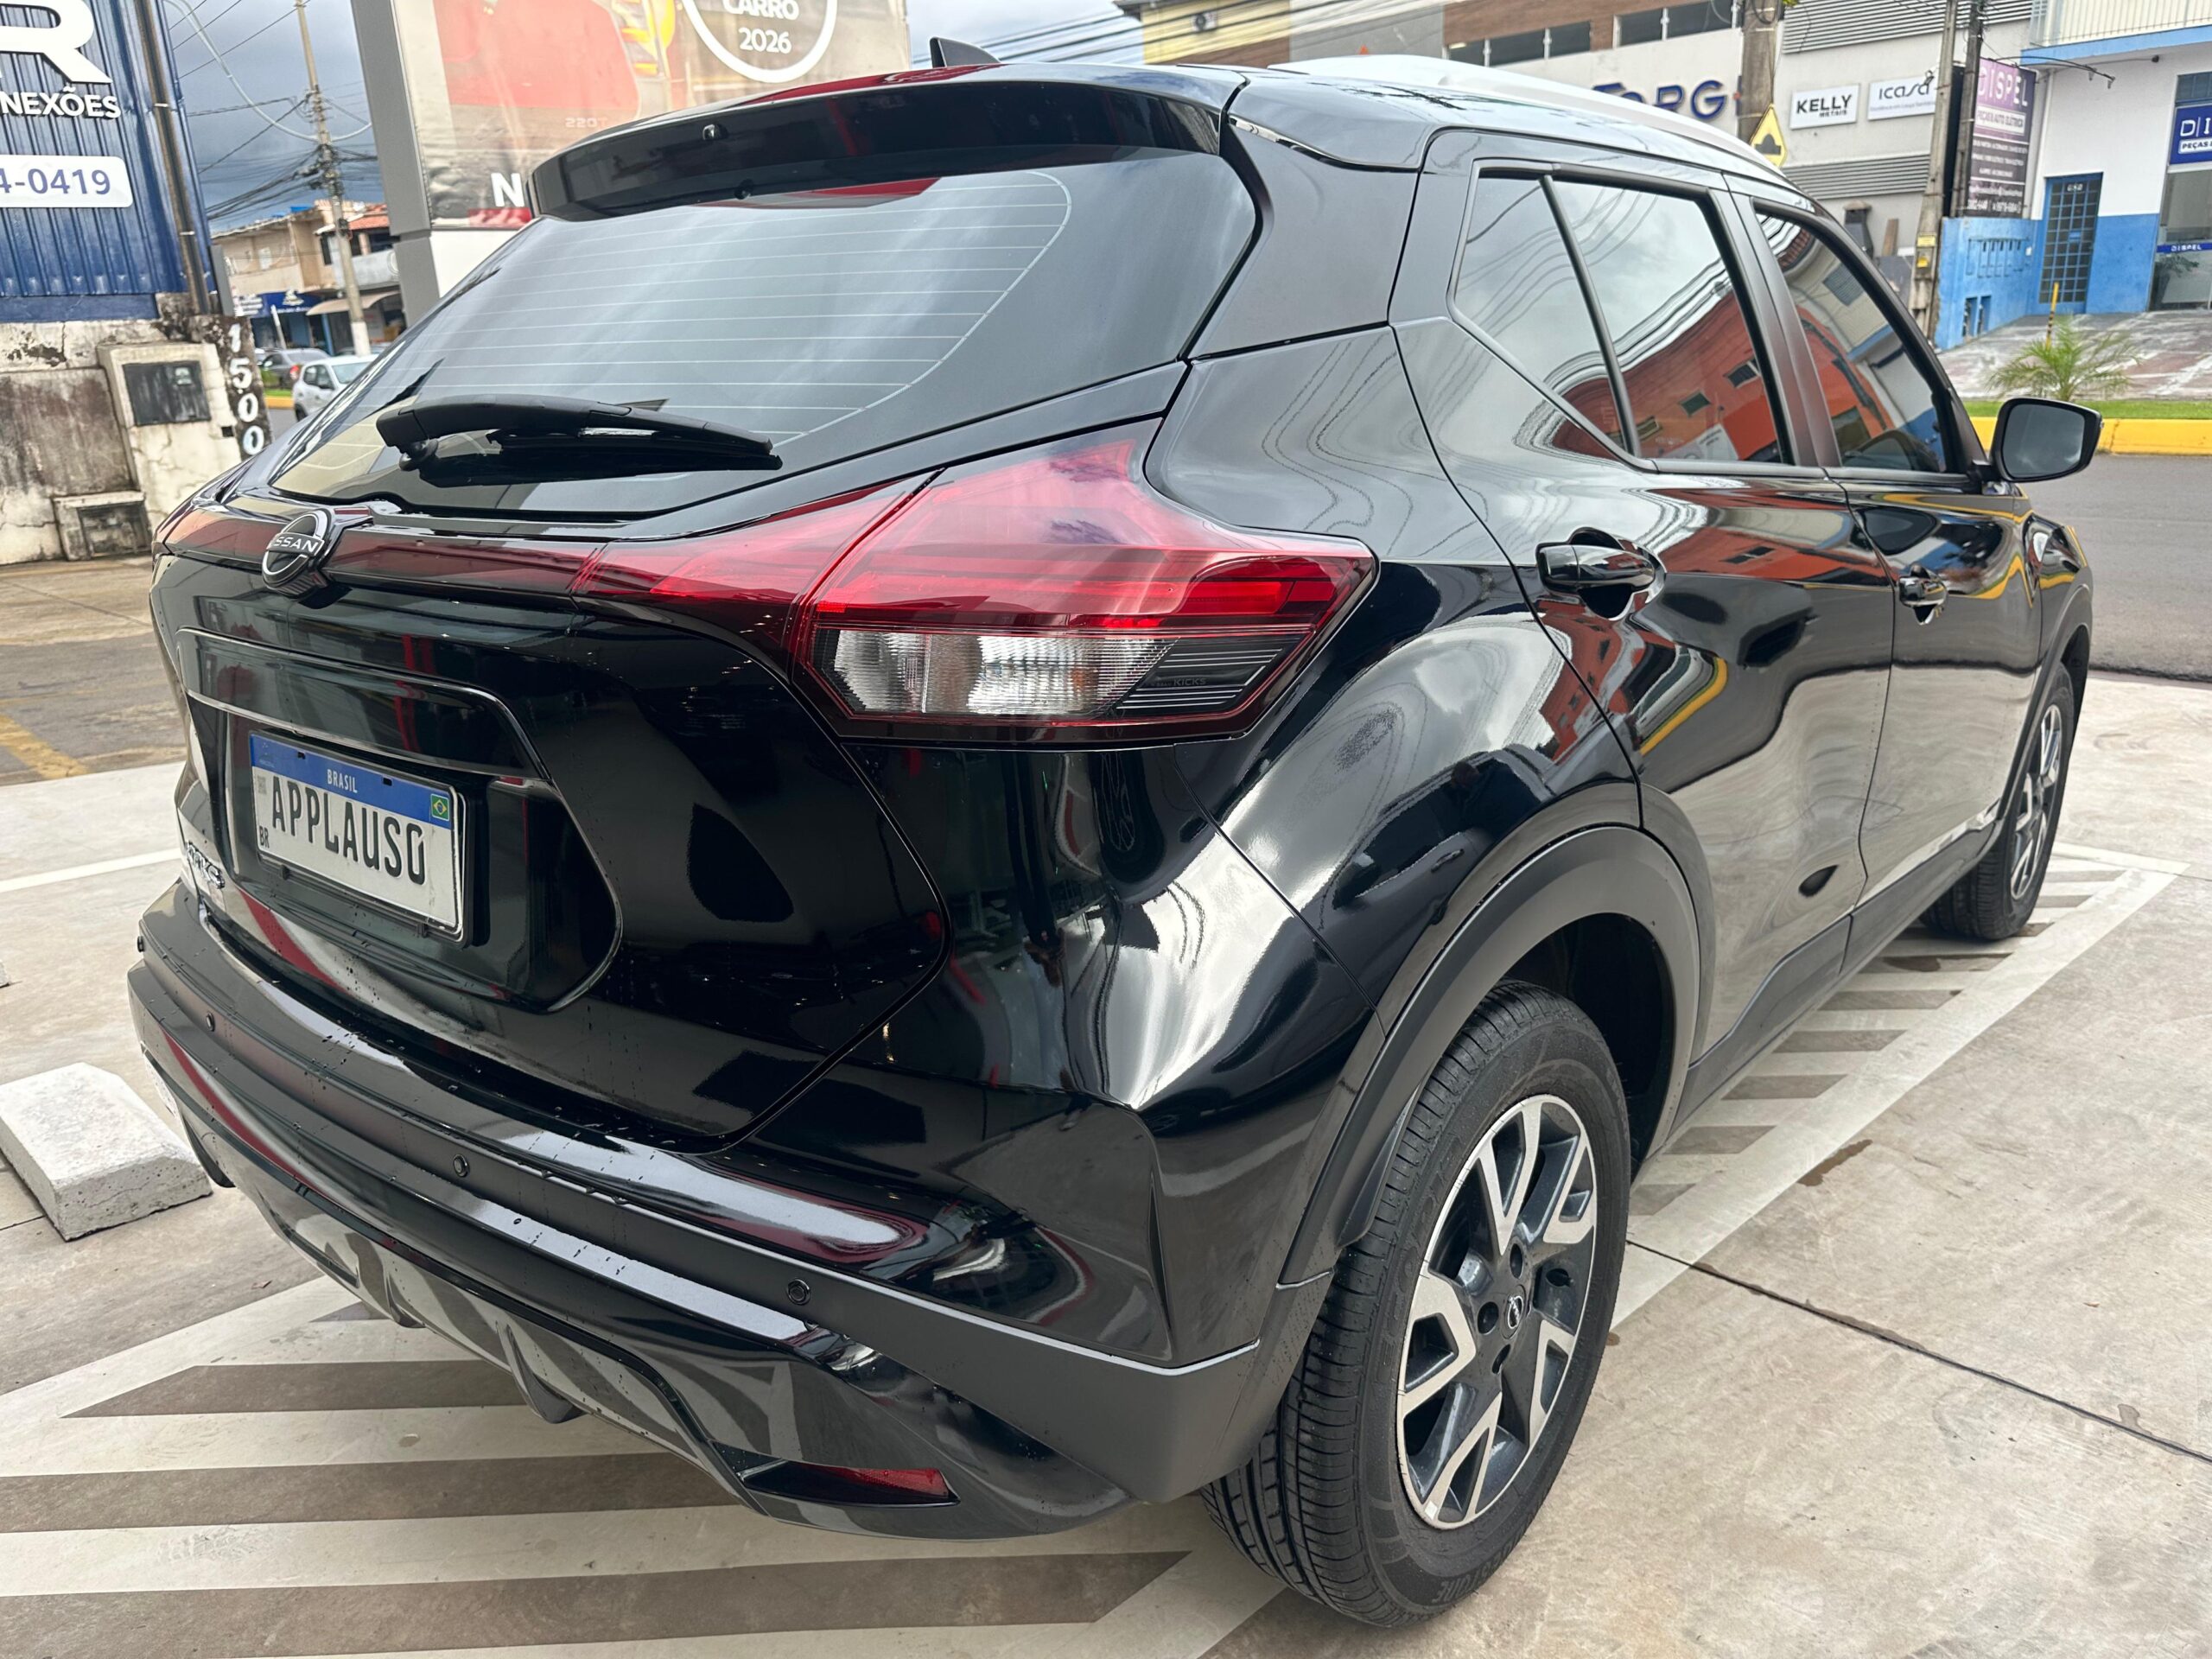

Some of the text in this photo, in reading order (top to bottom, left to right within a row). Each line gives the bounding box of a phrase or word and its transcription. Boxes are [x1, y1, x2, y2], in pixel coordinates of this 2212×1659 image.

[723, 0, 799, 21] CARRO
[739, 27, 791, 54] 2026
[1977, 66, 2028, 106] DISPEL
[1592, 79, 1726, 120] RG
[1796, 94, 1852, 113] KELLY
[2182, 141, 2209, 150] PEÇAS
[491, 173, 524, 207] N
[1173, 677, 1206, 686] KICKS
[327, 768, 359, 794] BRASIL
[259, 825, 270, 849] BR
[272, 775, 426, 887] APPLAUSO
